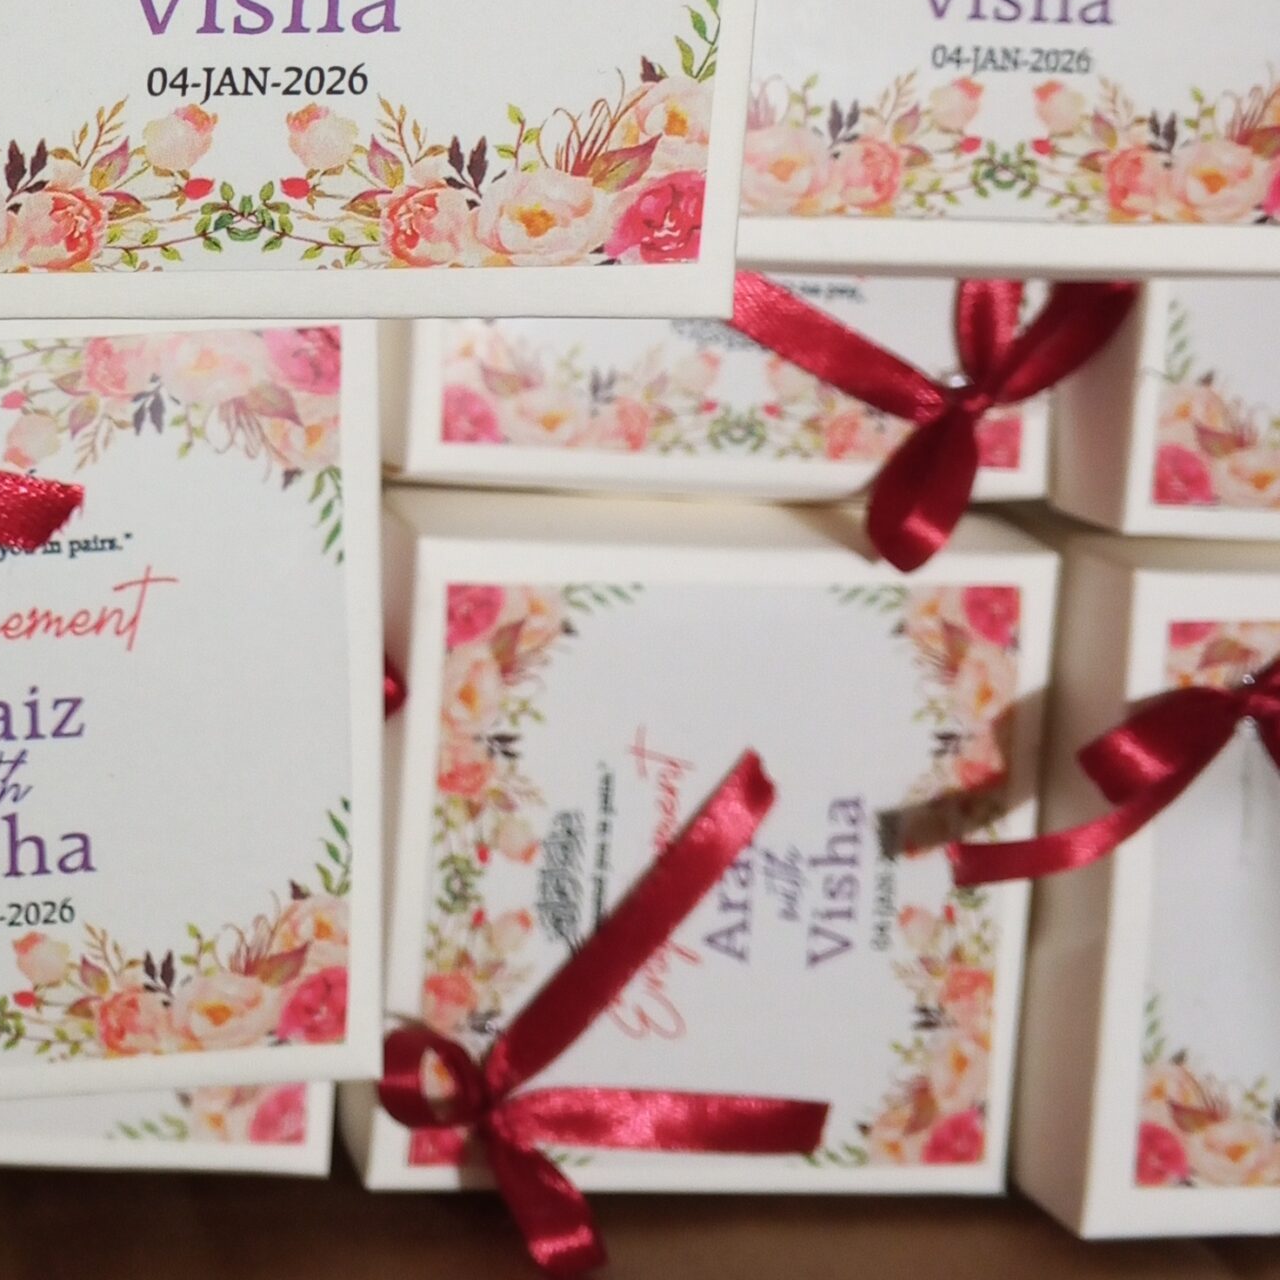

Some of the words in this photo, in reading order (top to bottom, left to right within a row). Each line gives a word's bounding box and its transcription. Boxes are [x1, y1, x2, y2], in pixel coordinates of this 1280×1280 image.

[931, 44, 1093, 76] 04-JAN-2026
[146, 63, 368, 105] 04-JAN-2026
[70, 532, 132, 558] pairs."
[805, 793, 866, 968] Visha
[701, 841, 754, 963] Ara
